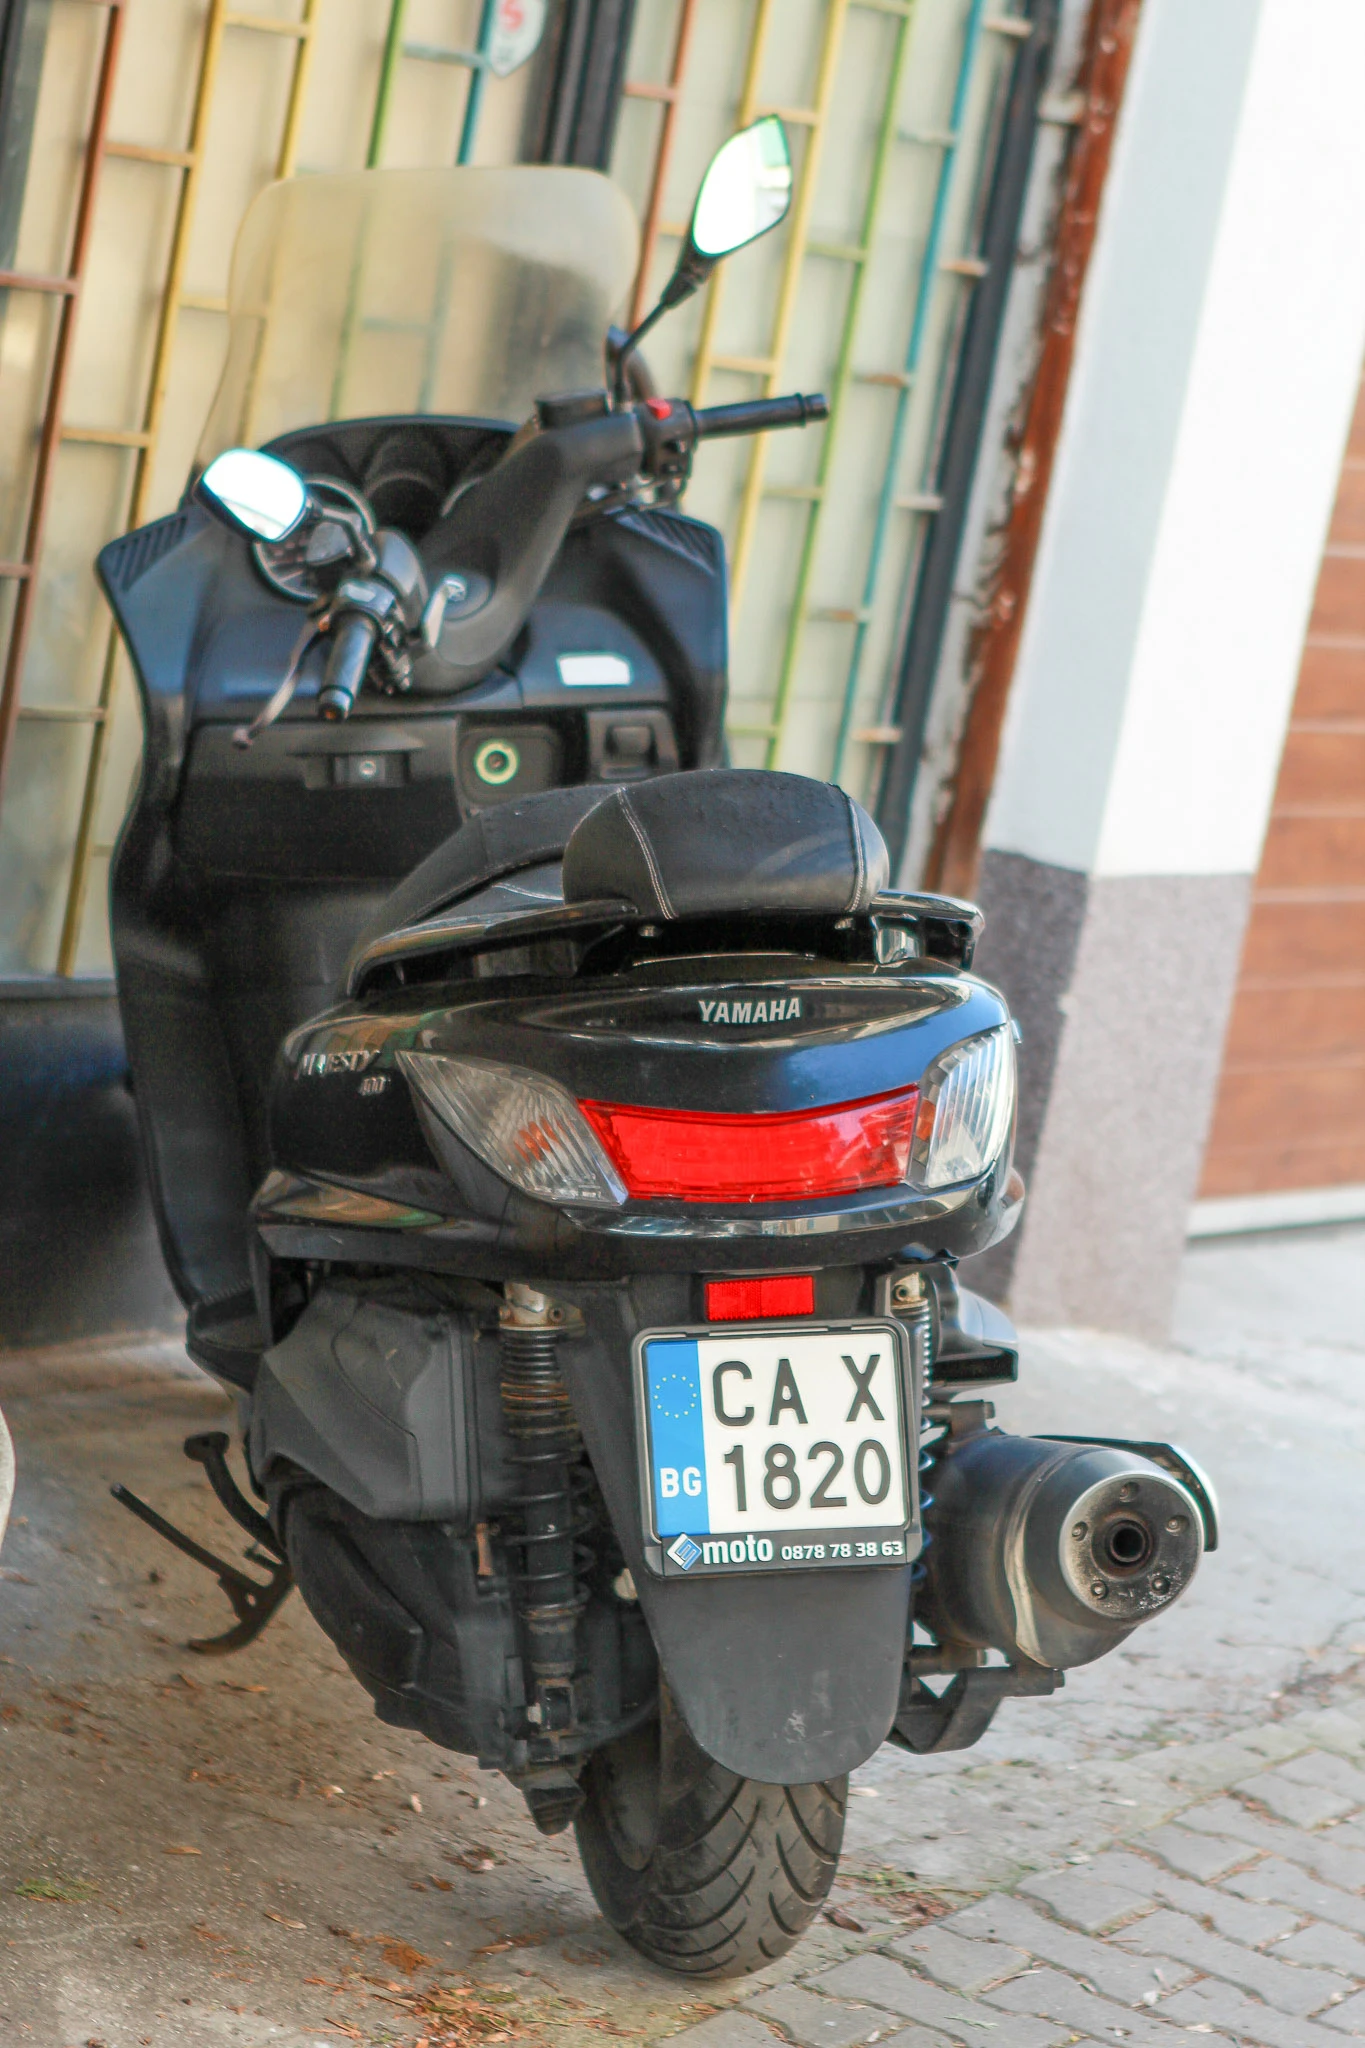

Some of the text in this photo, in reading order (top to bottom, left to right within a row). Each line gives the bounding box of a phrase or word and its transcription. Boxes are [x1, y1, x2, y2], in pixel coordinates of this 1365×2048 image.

[698, 997, 801, 1024] YAMAHA
[712, 1354, 885, 1427] CA X
[659, 1466, 702, 1498] BG
[723, 1439, 891, 1512] 1820
[702, 1534, 904, 1565] moto 0878 78 38 63
